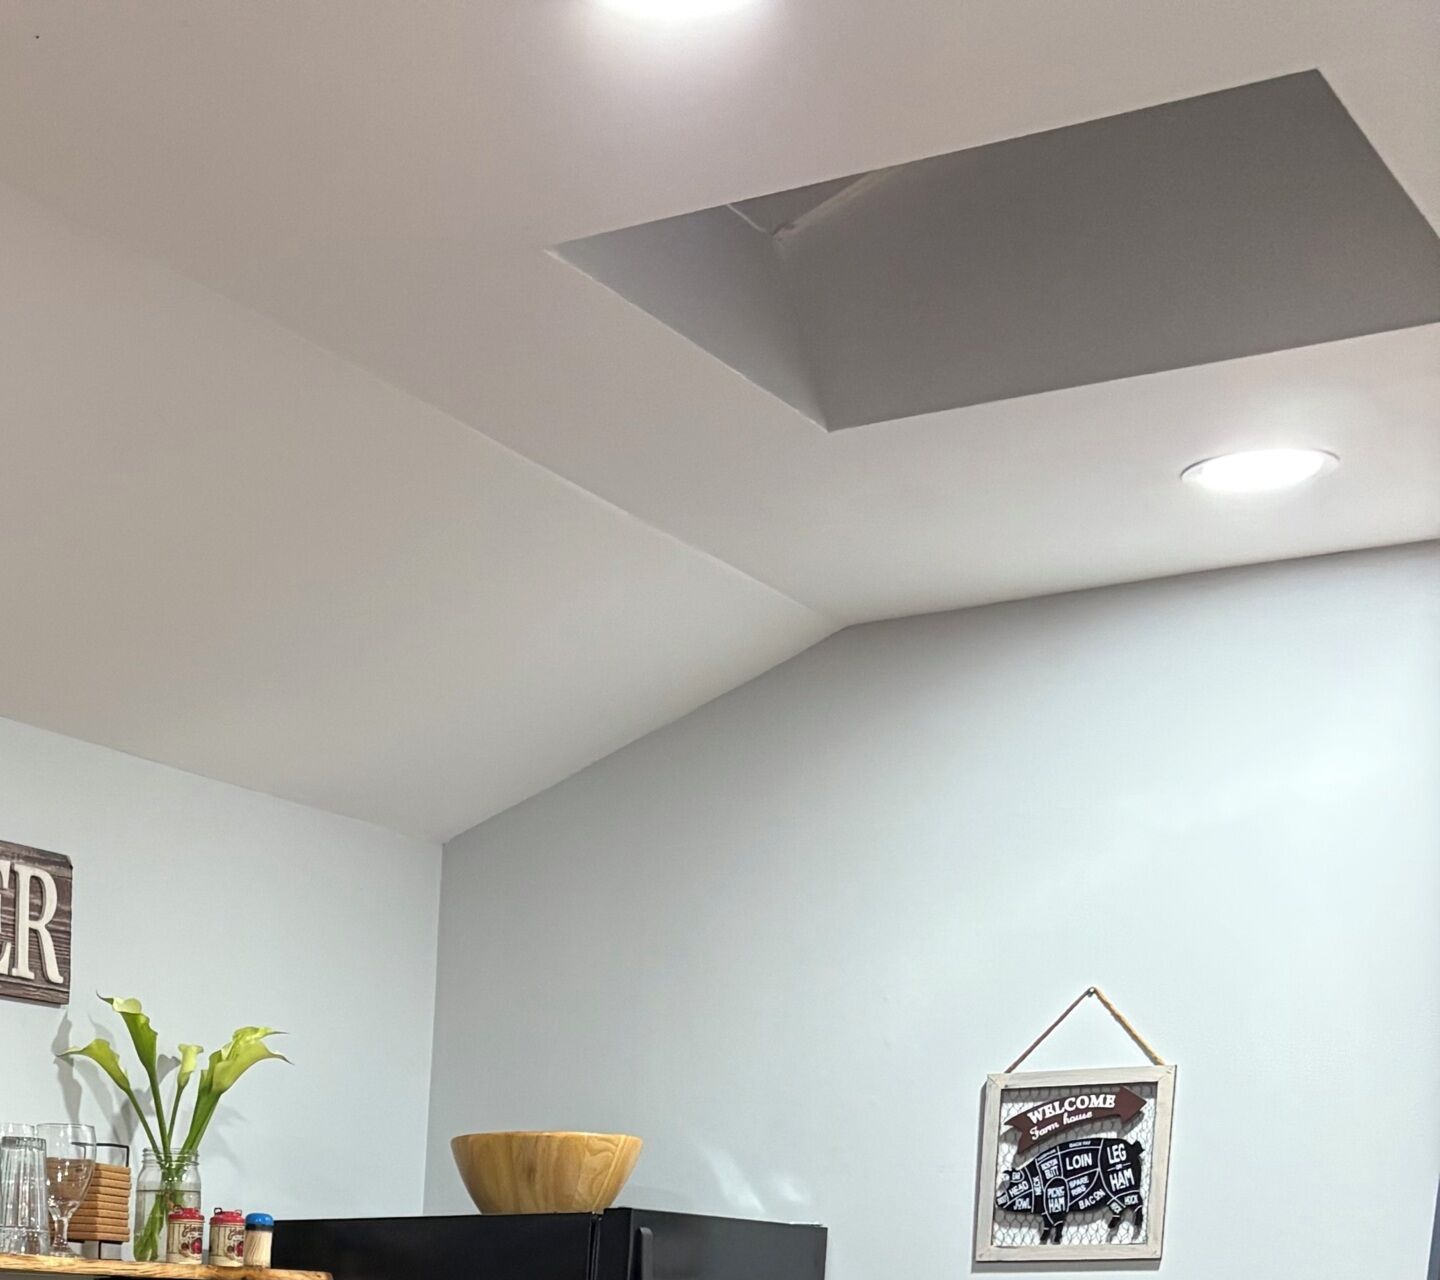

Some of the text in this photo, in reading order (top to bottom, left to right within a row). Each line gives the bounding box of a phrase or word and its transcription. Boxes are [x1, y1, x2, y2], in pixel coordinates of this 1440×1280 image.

[1027, 1094, 1116, 1124] WELCOME
[1029, 1111, 1093, 1140] Farm house
[1065, 1152, 1093, 1171] LOIN
[1107, 1143, 1127, 1164] LEG
[1008, 1180, 1030, 1198] HEAD
[1109, 1168, 1135, 1192] HAM
[1013, 1197, 1031, 1211] JOWL
[1048, 1197, 1066, 1214] HAM
[1078, 1188, 1106, 1210] BACON
